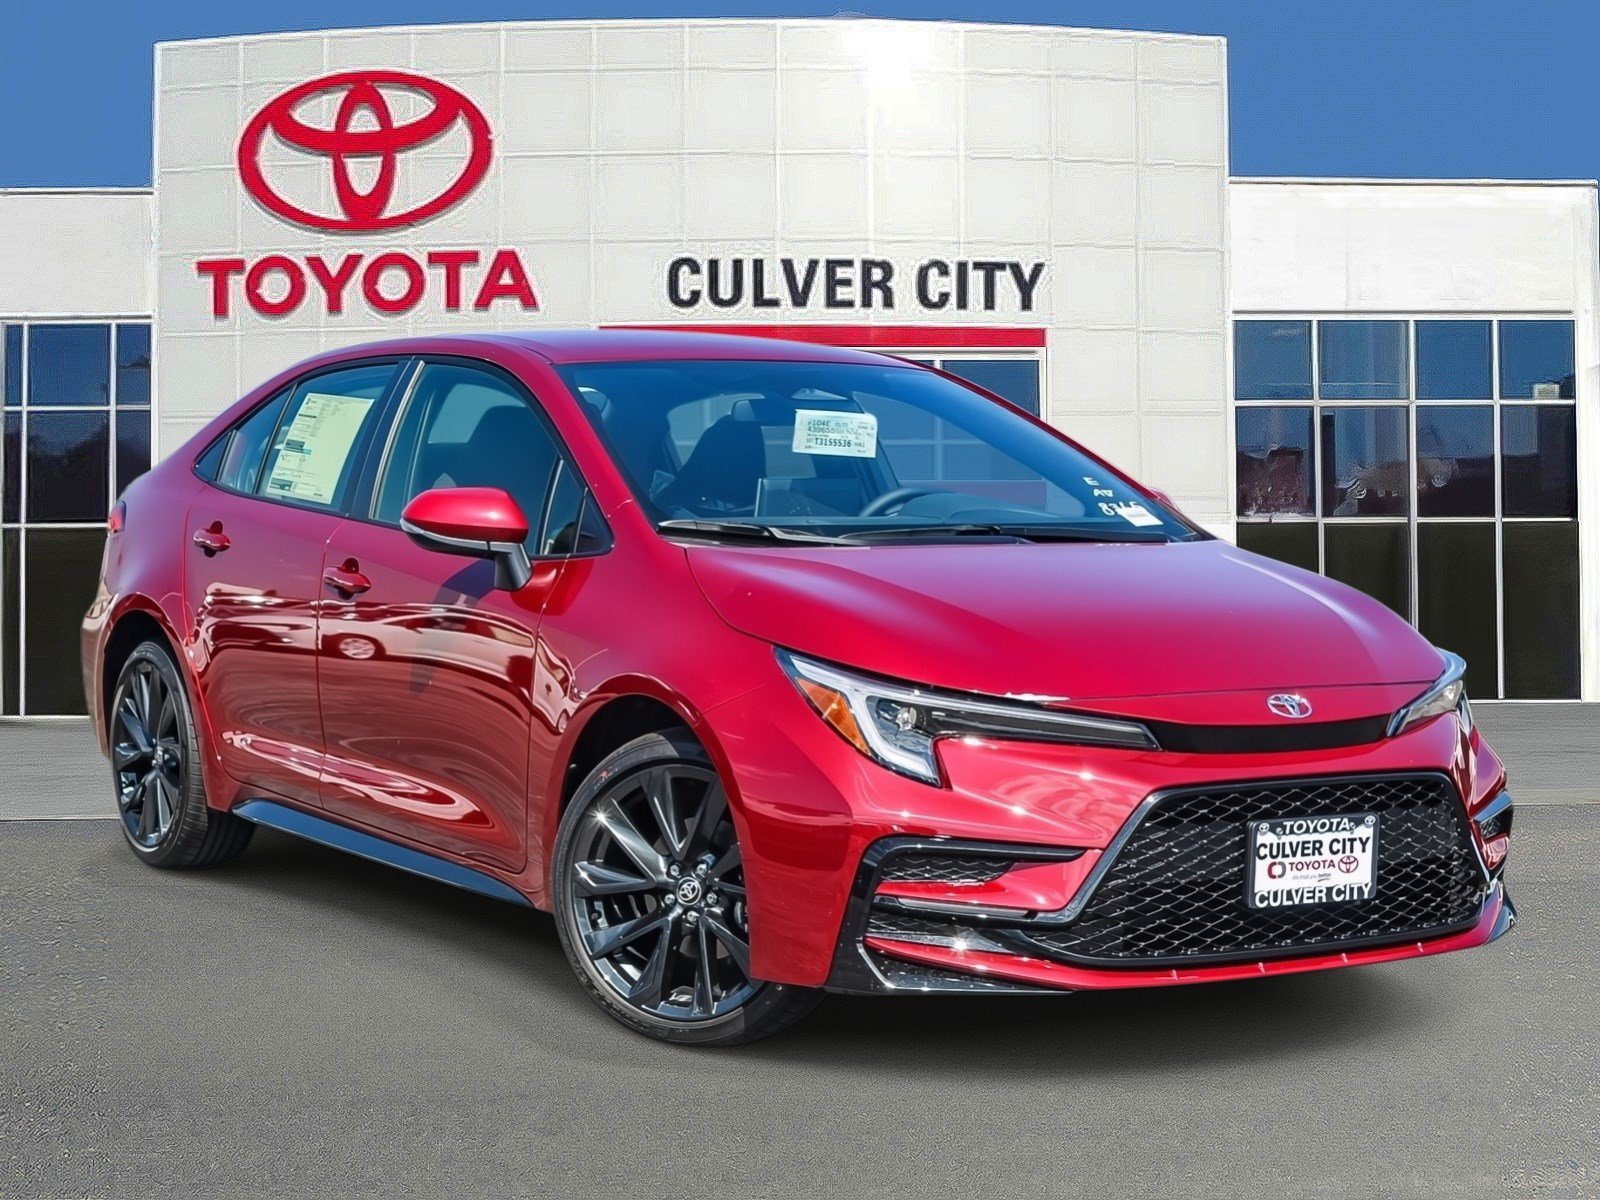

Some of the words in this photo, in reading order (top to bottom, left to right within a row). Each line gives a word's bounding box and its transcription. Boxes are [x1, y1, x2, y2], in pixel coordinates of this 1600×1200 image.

[196, 249, 539, 318] TOYOTA
[667, 257, 895, 309] CULVER
[916, 259, 1045, 311] CITY
[1283, 818, 1350, 835] TOYOTA
[1256, 839, 1324, 861] CULVER
[1328, 836, 1371, 856] CITY
[1288, 859, 1336, 872] TOYOTA
[1255, 885, 1327, 908] CULVER
[1331, 881, 1372, 902] CITY
